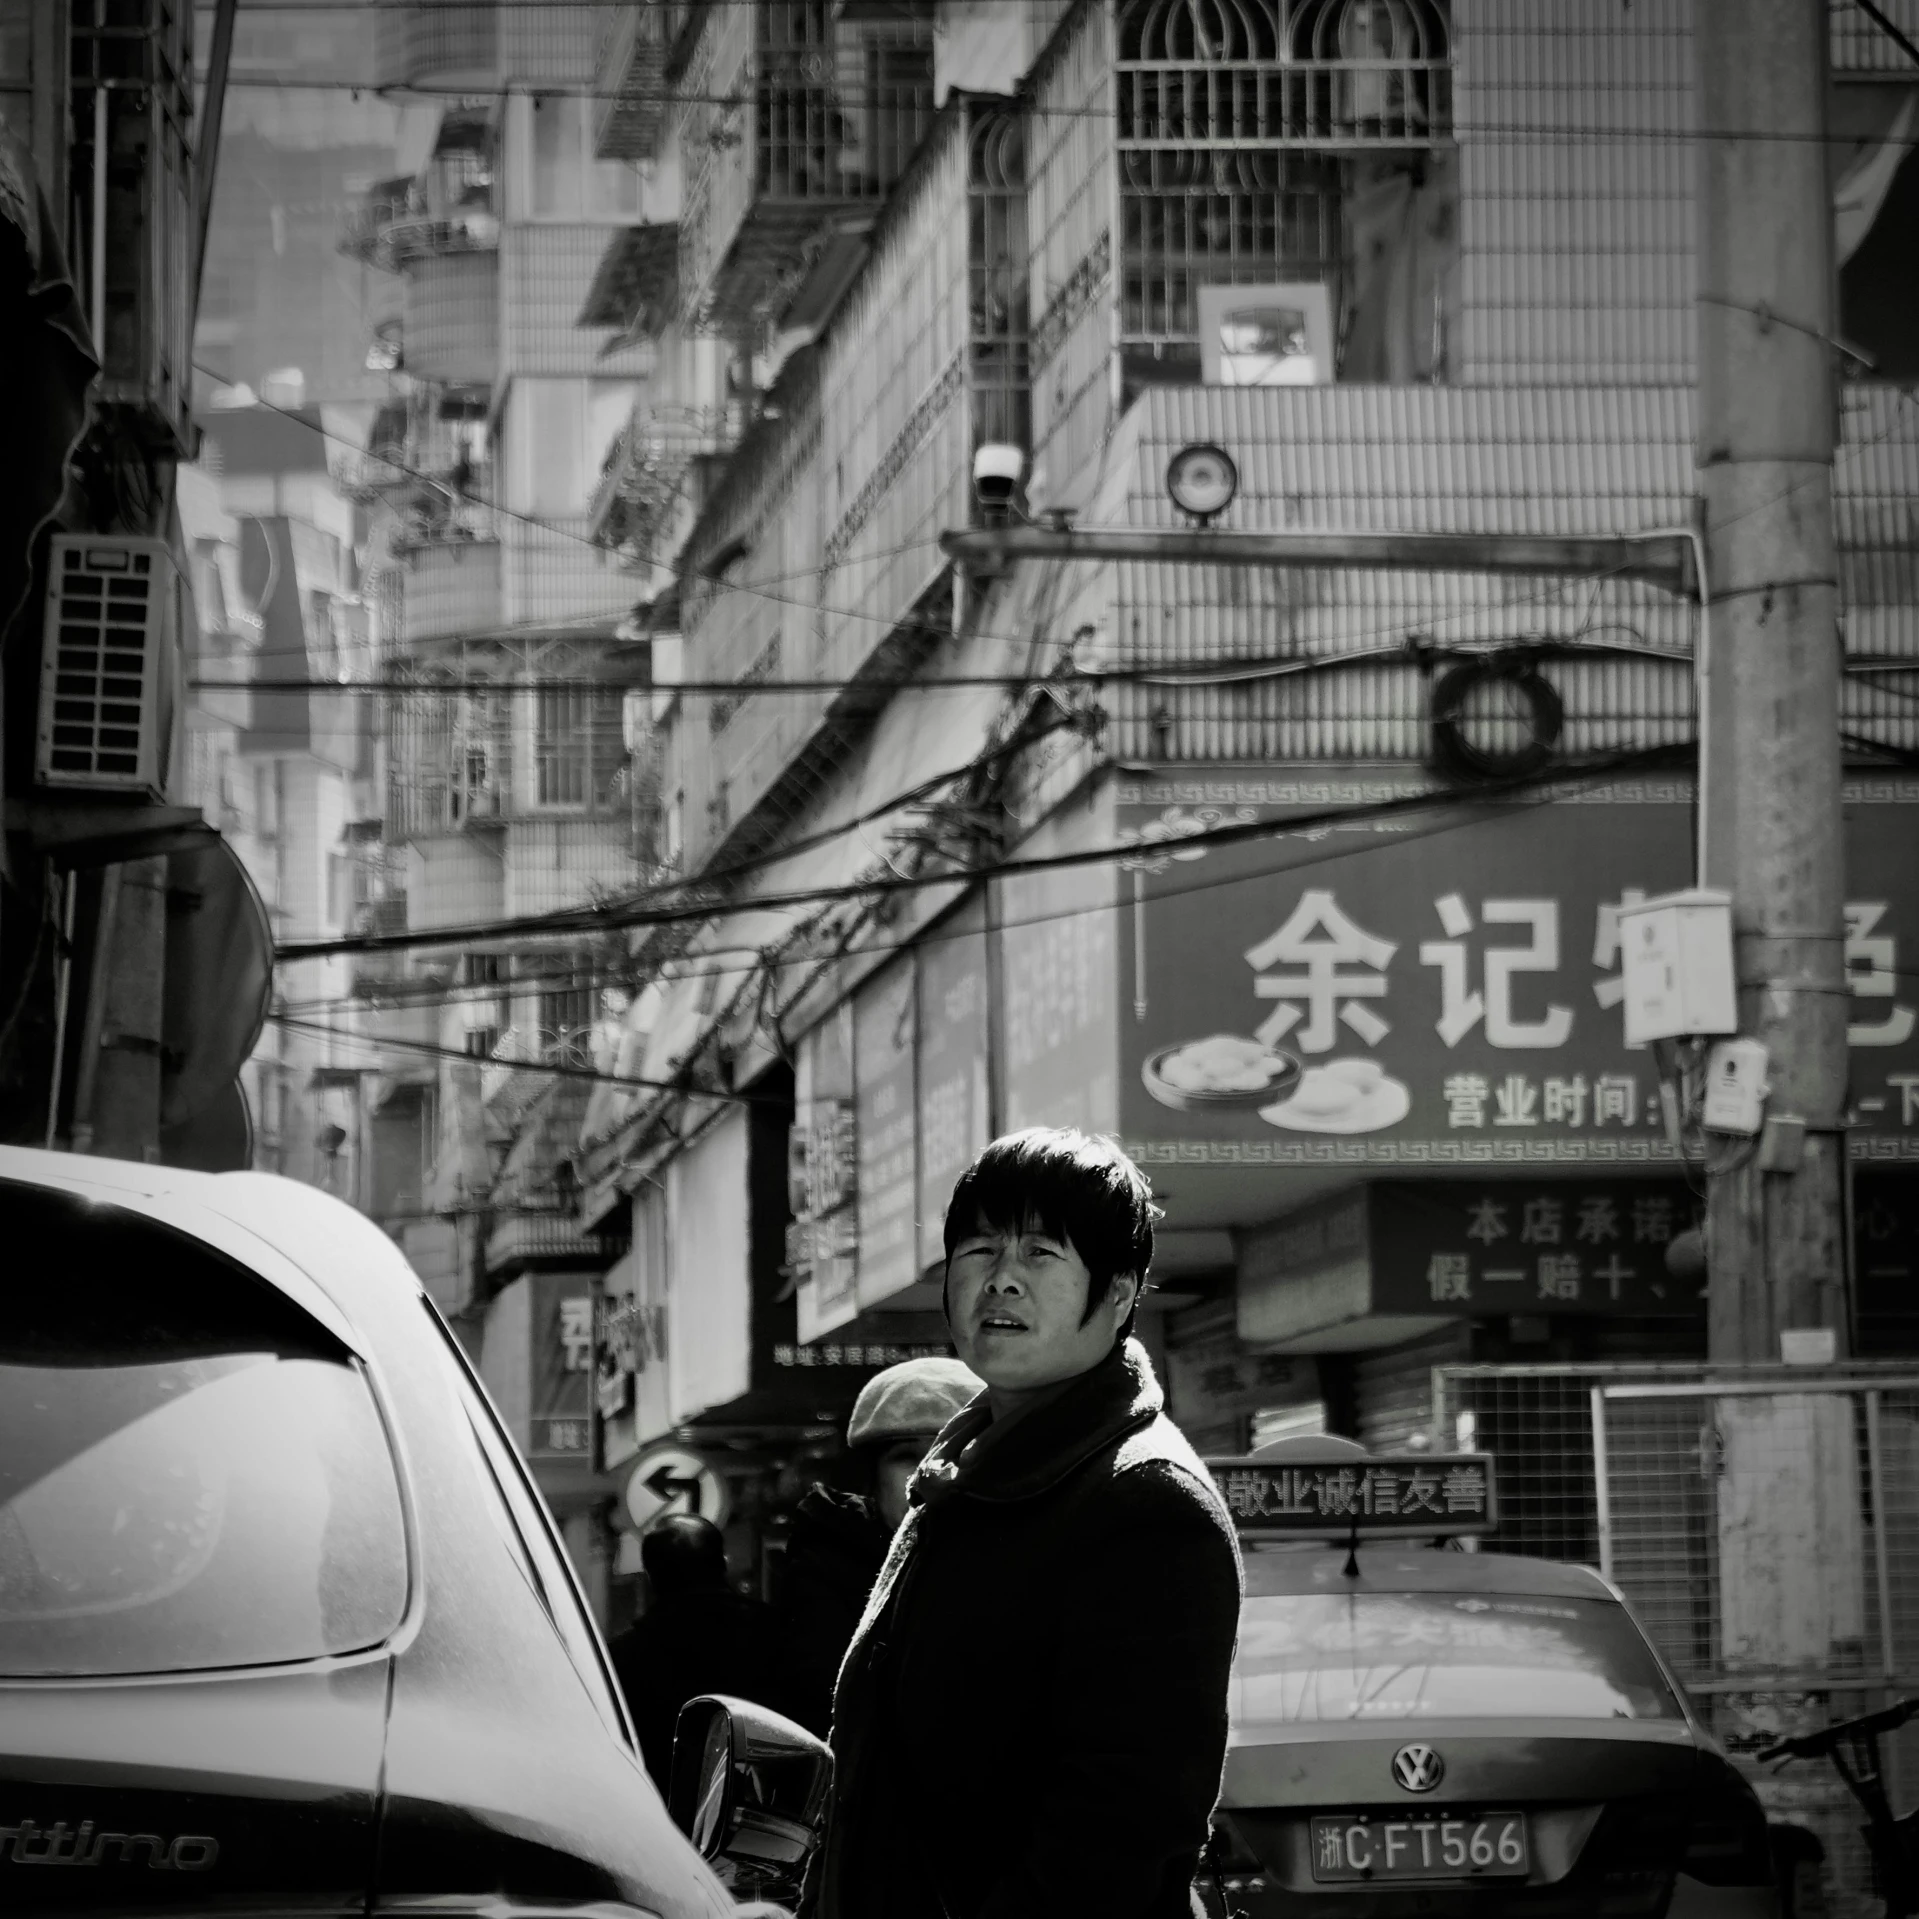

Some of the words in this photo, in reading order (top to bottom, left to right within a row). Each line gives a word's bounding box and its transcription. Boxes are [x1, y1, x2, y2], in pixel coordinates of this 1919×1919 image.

[1213, 1465, 1486, 1517] 敬业诚信友善
